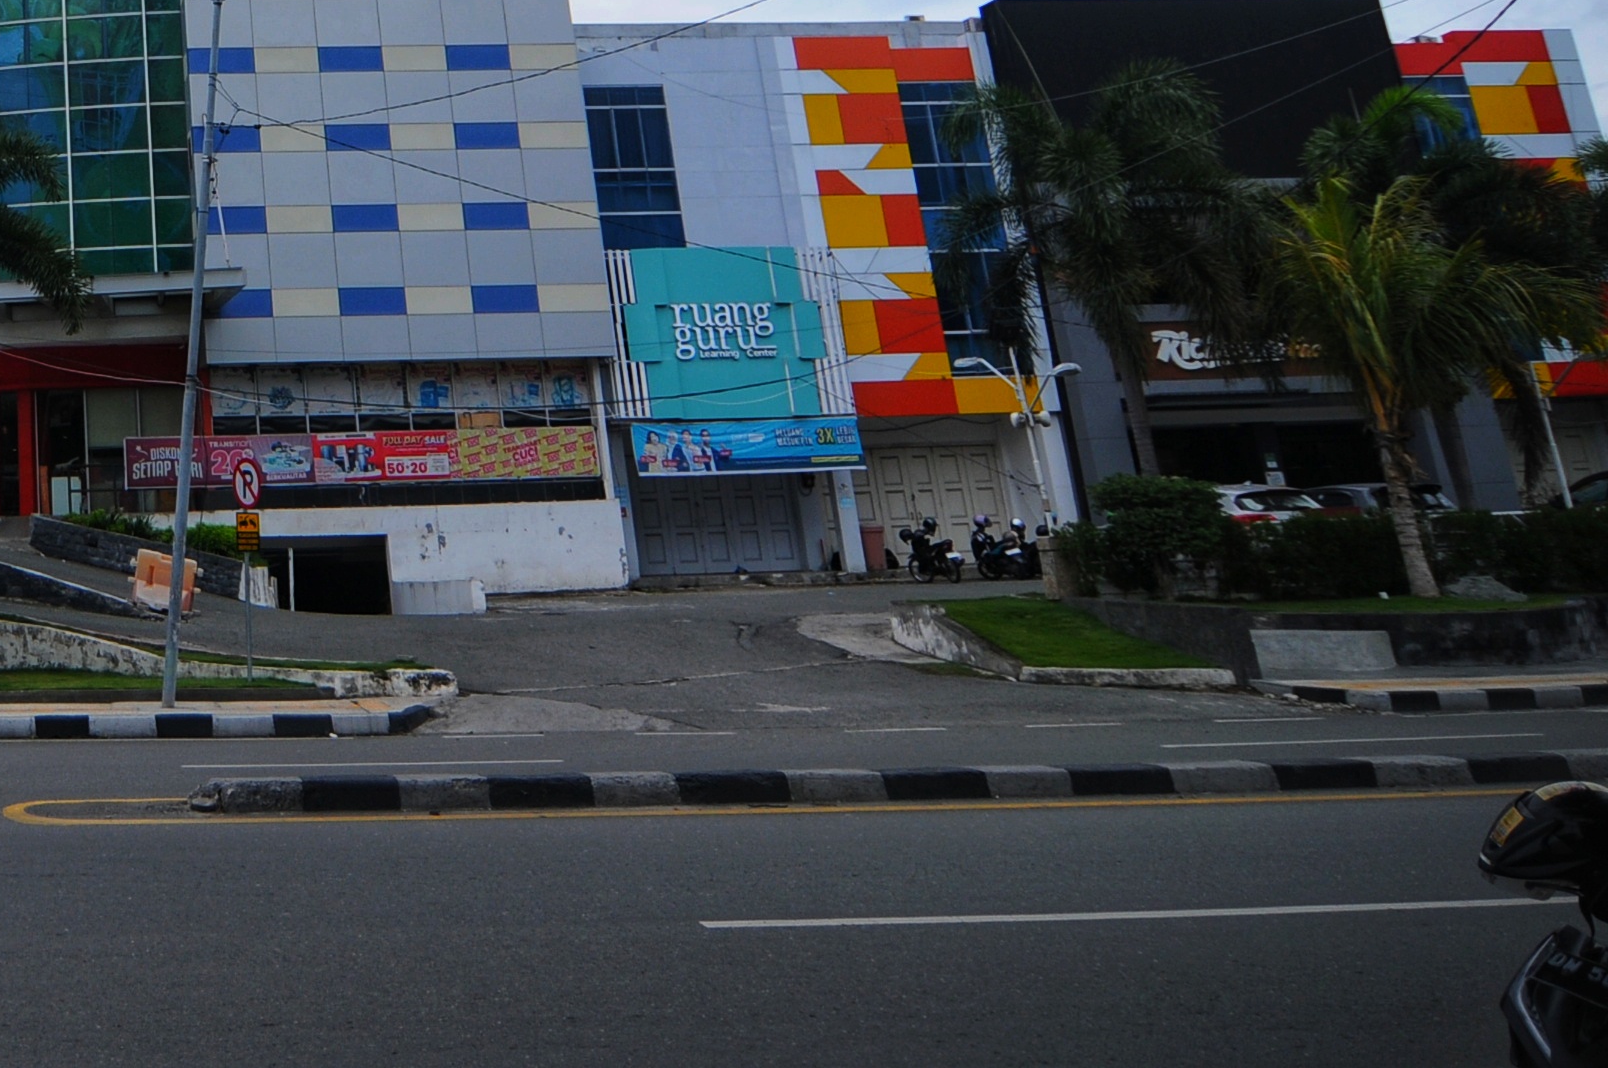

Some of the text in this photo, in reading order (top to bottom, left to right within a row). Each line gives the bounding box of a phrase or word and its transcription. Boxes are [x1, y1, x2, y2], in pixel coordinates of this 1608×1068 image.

[671, 301, 775, 337] ruang
[674, 324, 760, 361] guru
[699, 347, 778, 361] Learning Center
[424, 434, 446, 445] SALE
[816, 427, 835, 444] 3X
[512, 446, 539, 461] CUCI
[132, 460, 203, 480] SETIAP HRI
